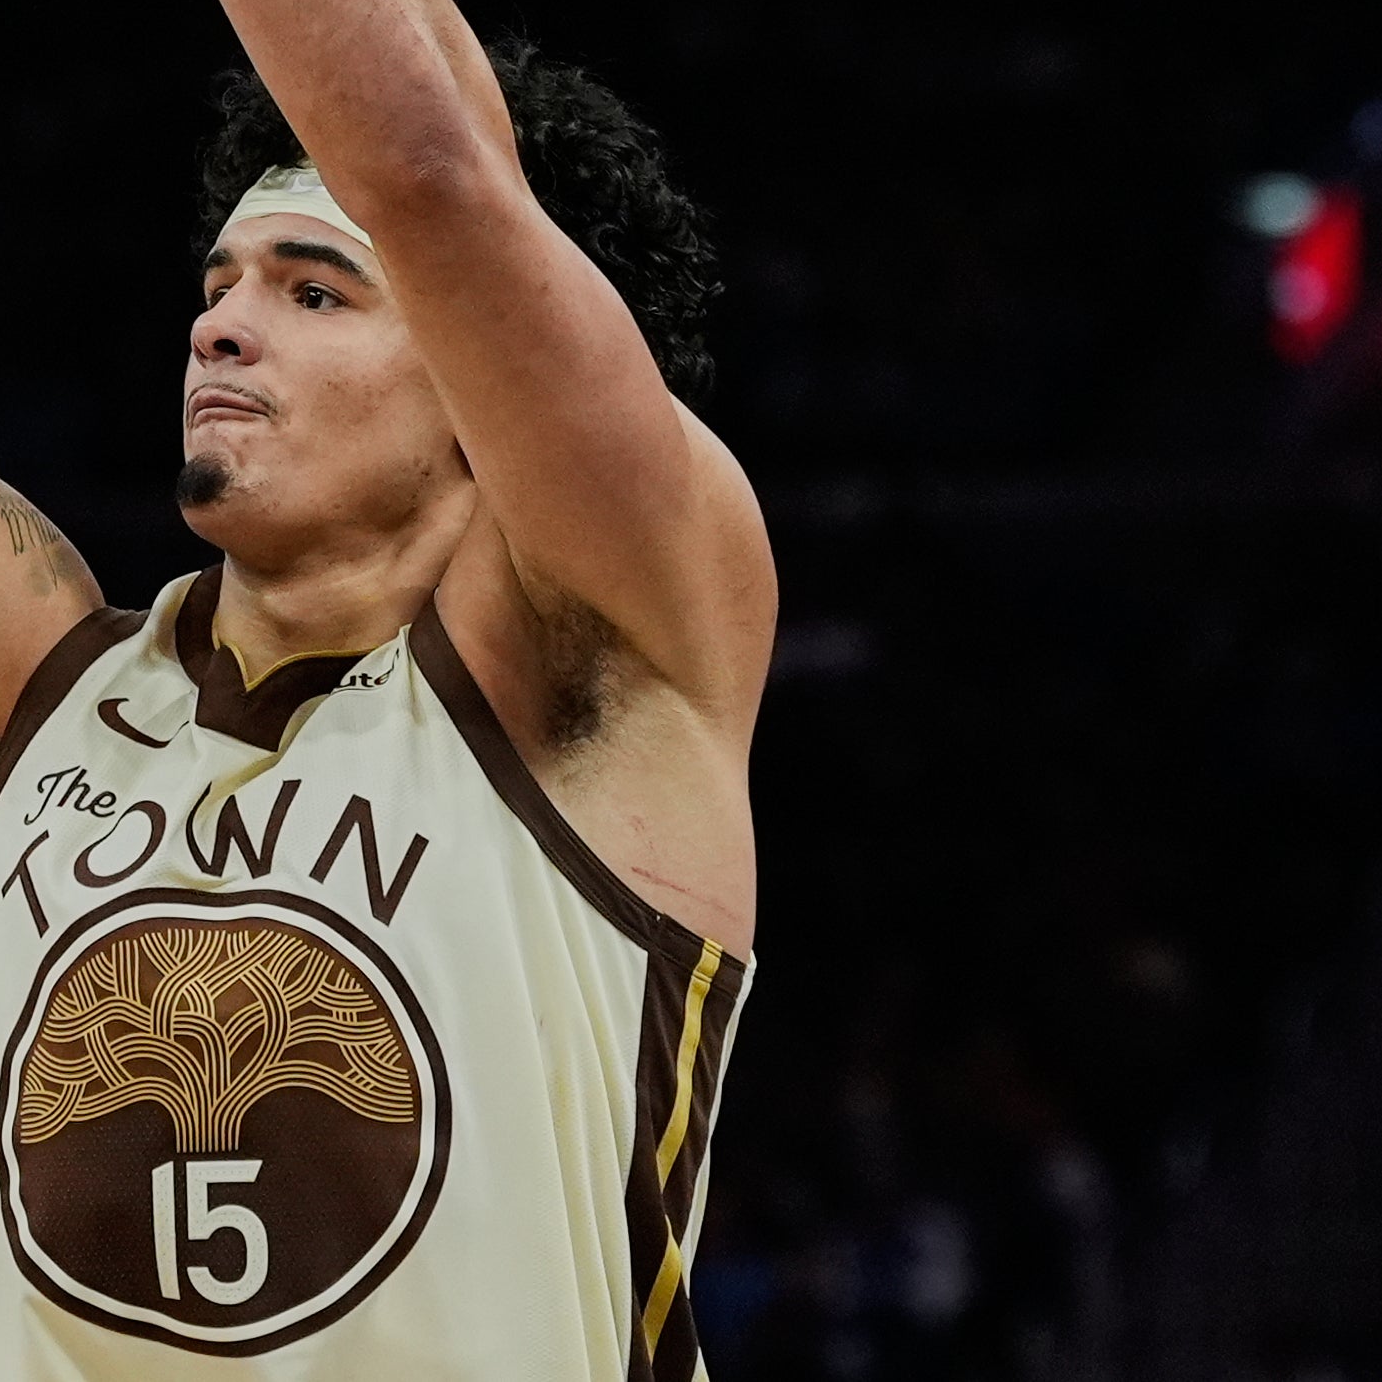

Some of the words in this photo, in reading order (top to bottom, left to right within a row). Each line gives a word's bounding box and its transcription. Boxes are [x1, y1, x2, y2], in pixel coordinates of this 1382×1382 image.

[1, 778, 431, 939] TOWN
[24, 765, 117, 826] The
[151, 1158, 271, 1306] 15
